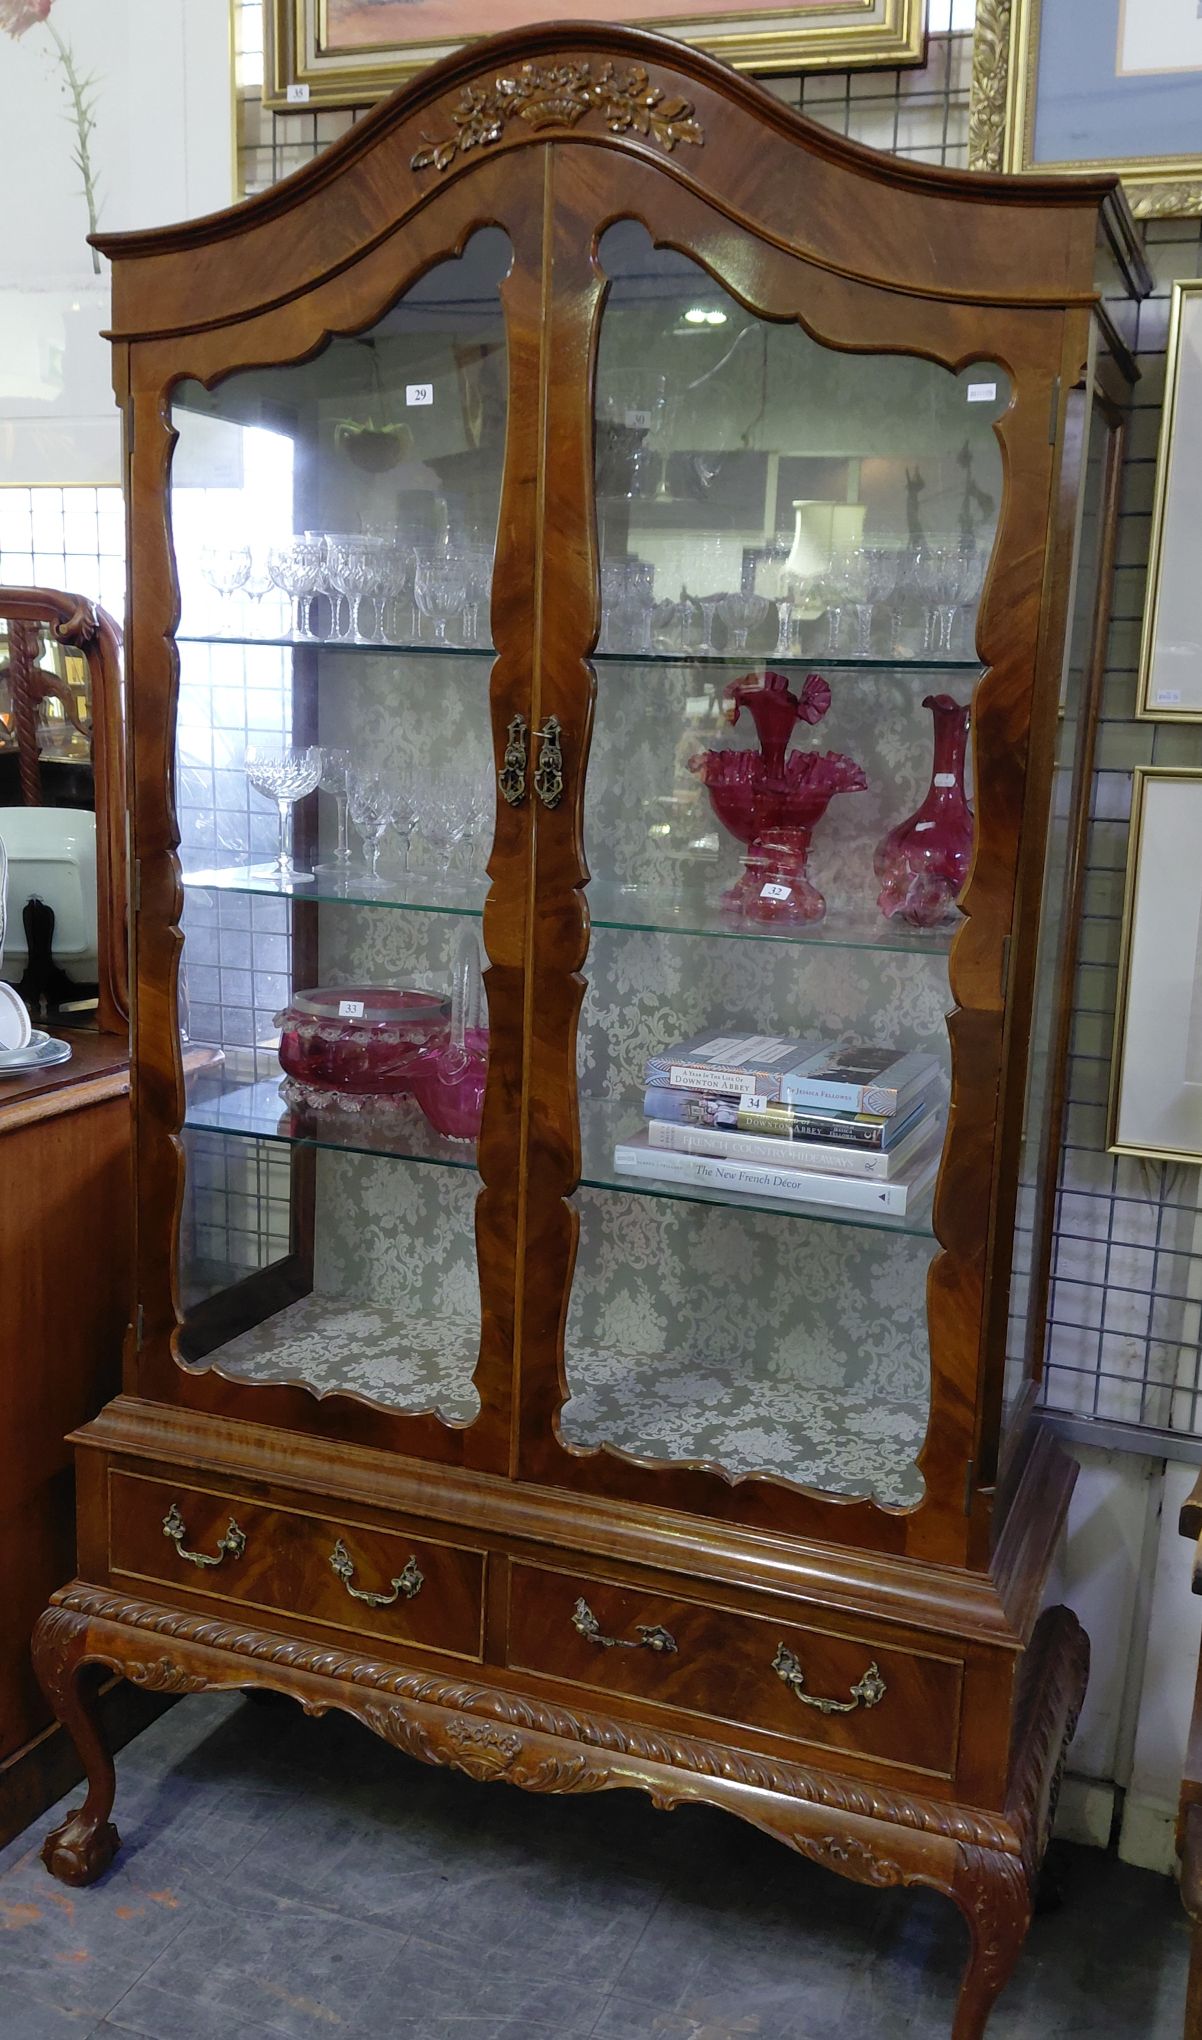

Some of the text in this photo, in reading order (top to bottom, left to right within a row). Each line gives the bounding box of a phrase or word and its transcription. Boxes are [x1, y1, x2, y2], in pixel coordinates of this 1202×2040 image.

[415, 389, 427, 401] 29
[767, 886, 783, 896] 32
[345, 1004, 357, 1014] 33
[675, 1075, 750, 1092] DOWNTON ABBEY
[746, 1097, 760, 1108] 34
[746, 1117, 792, 1130] DOWNTON
[794, 1124, 822, 1136] ABBEY
[683, 1135, 728, 1151] FRENCH
[732, 1142, 788, 1159] COUNTRY
[793, 1152, 854, 1168] HIDEAWAYS
[696, 1165, 713, 1176] The
[715, 1167, 737, 1180] New
[739, 1171, 770, 1185] French
[773, 1175, 802, 1190] Décor
